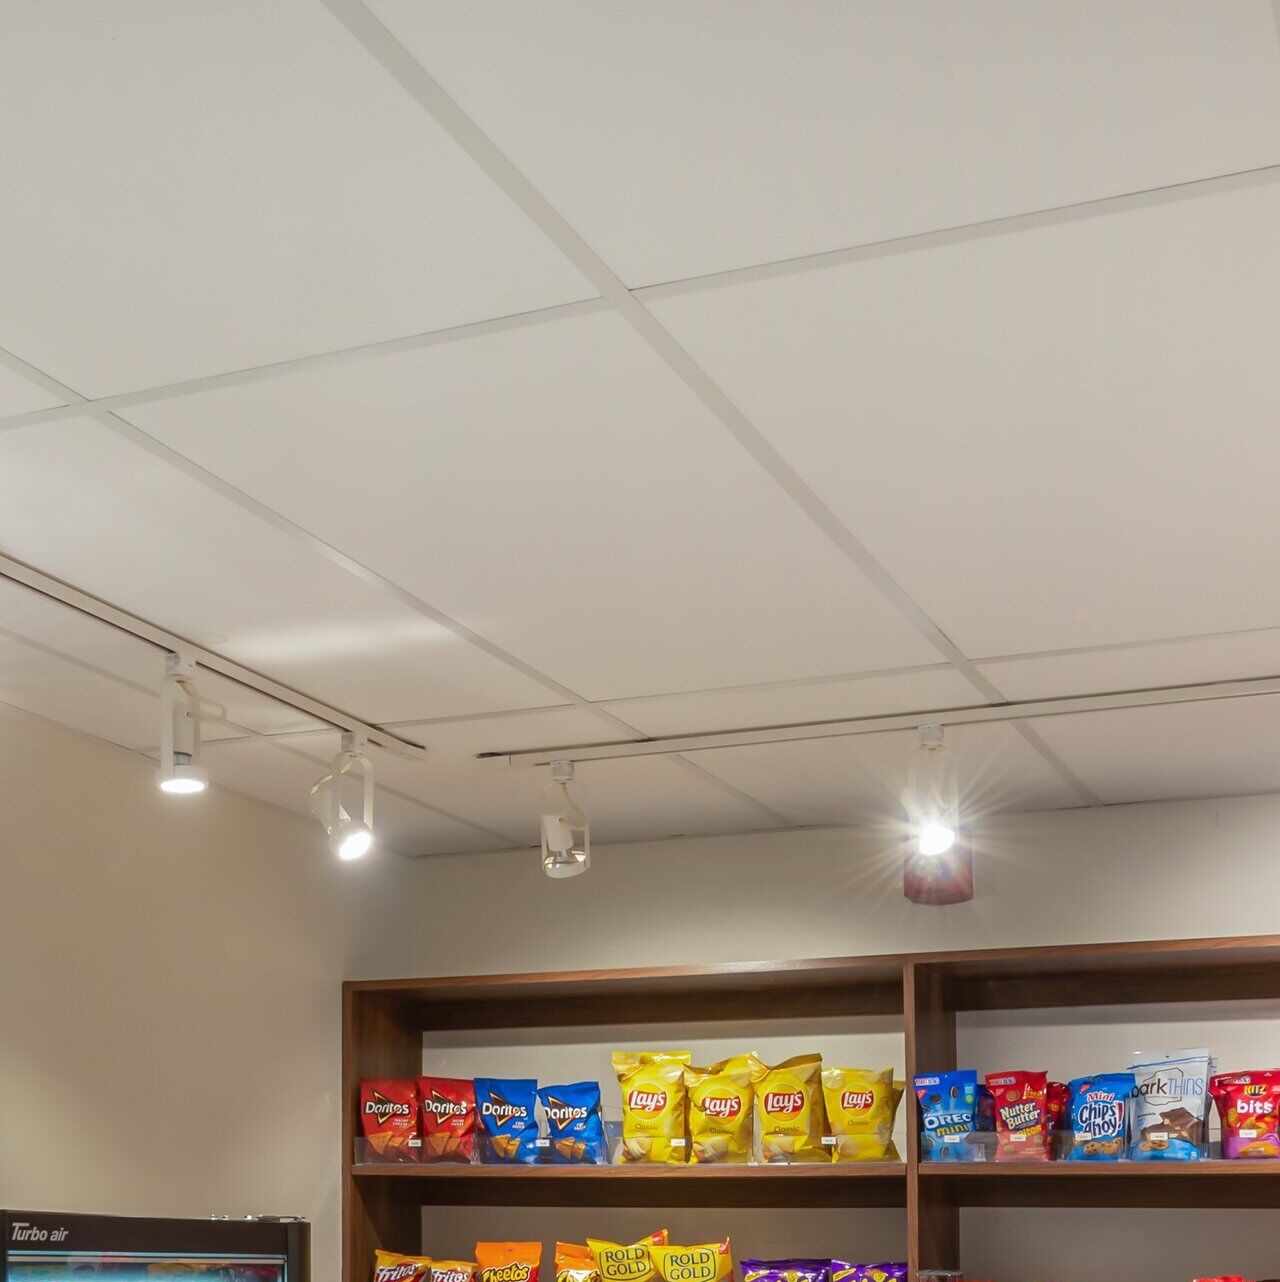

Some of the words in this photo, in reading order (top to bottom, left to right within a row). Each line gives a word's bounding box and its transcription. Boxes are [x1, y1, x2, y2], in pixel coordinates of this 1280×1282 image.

[1087, 1091, 1114, 1102] Mini
[1244, 1084, 1267, 1095] RITZ
[424, 1098, 467, 1116] Doritos
[629, 1090, 667, 1110] Lay's
[704, 1096, 739, 1115] Lay's
[766, 1091, 805, 1111] Lay's
[840, 1091, 874, 1109] Lay's
[1236, 1099, 1273, 1114] bits
[365, 1101, 410, 1117] Doritos
[482, 1101, 528, 1117] Doritos
[544, 1105, 588, 1120] Doritos
[1000, 1101, 1036, 1119] Nutter
[1080, 1102, 1116, 1124] Chips
[847, 1119, 869, 1128] Classic
[1006, 1109, 1042, 1129] Butter
[634, 1123, 660, 1132] Classic
[709, 1126, 735, 1135] Classic
[773, 1125, 800, 1135] Classic
[936, 1124, 969, 1136] mini
[11, 1222, 47, 1242] Turbo
[50, 1226, 69, 1242] air
[606, 1247, 646, 1266] ROLD
[670, 1252, 709, 1268] ROLD
[606, 1263, 650, 1280] GOLD
[669, 1265, 717, 1281] GOLD
